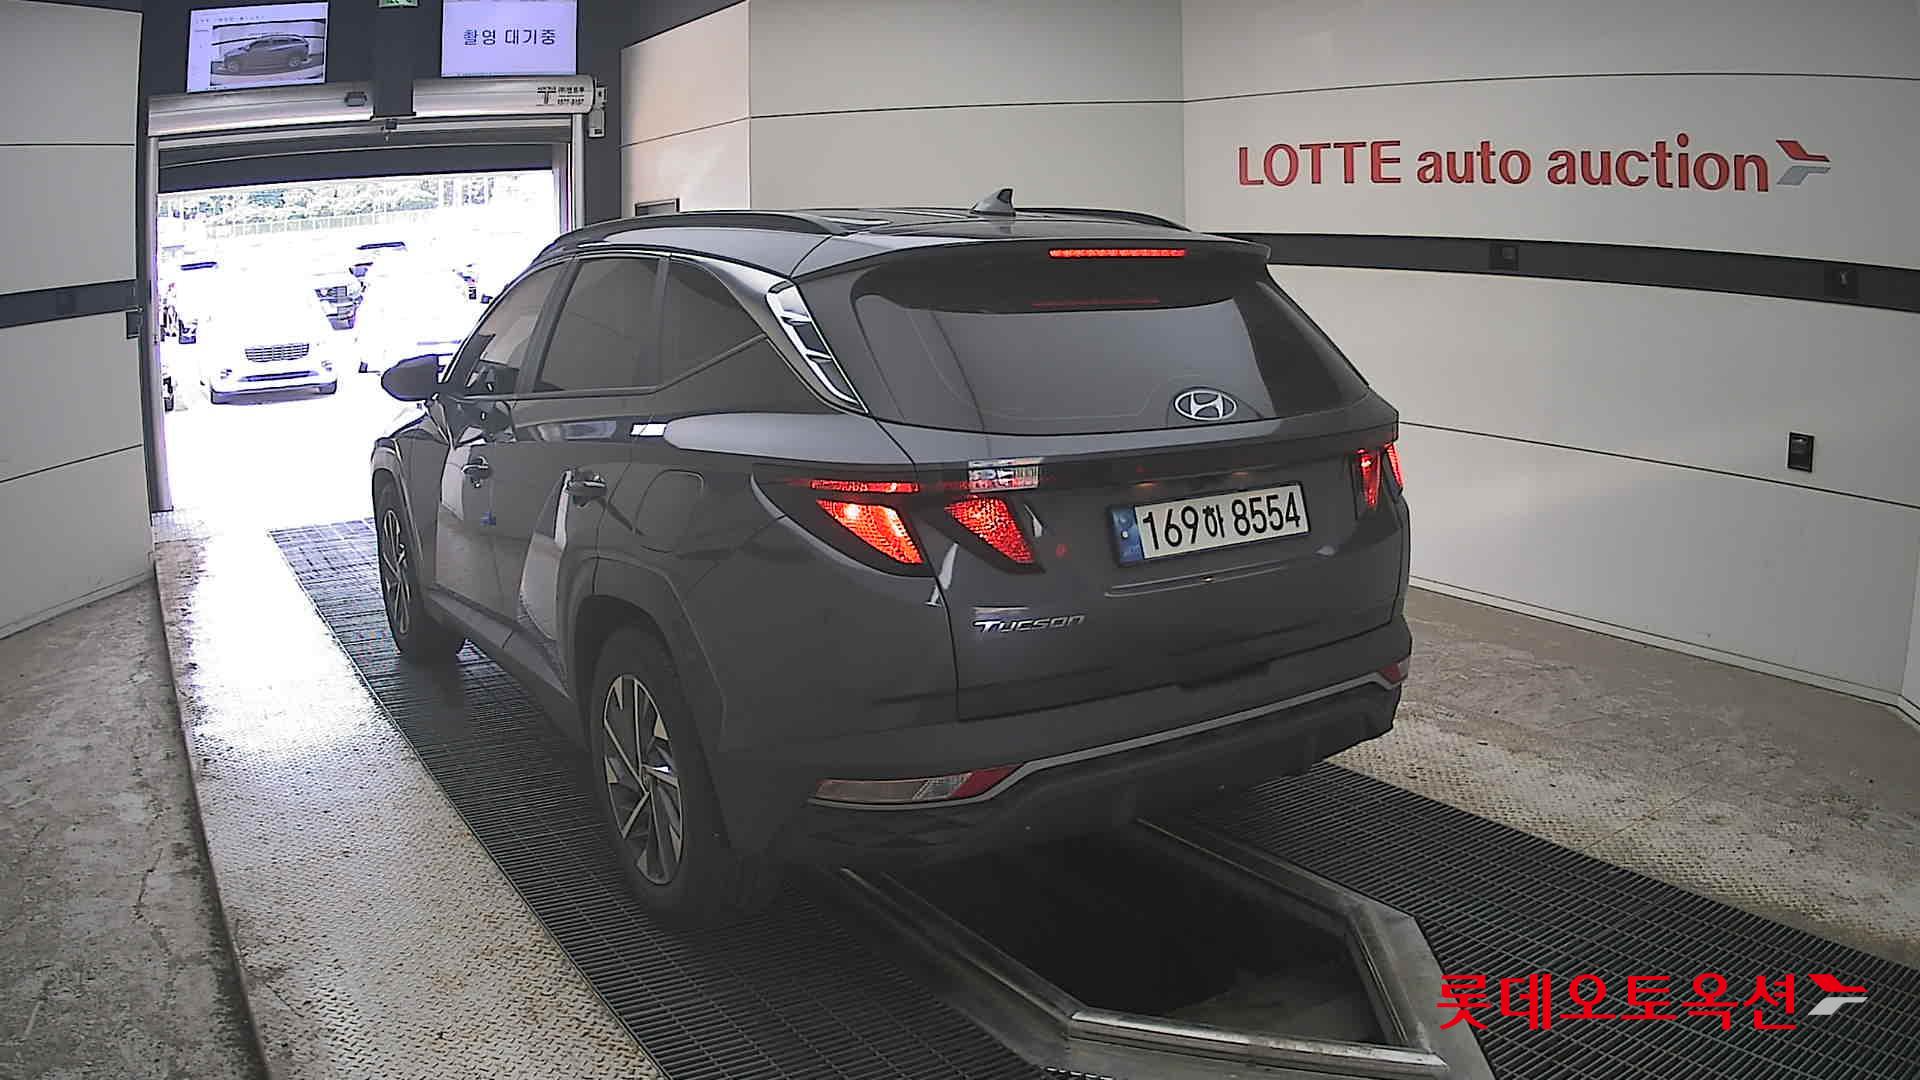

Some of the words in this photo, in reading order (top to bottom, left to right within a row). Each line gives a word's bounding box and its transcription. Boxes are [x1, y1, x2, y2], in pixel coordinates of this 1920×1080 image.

[464, 29, 496, 46] 촬영
[504, 29, 556, 45] 대기중
[1238, 140, 1402, 186] LOTTE
[1417, 140, 1531, 184] auto
[1547, 133, 1769, 192] auction
[1142, 505, 1225, 550] 169하
[1231, 492, 1301, 537] 8554
